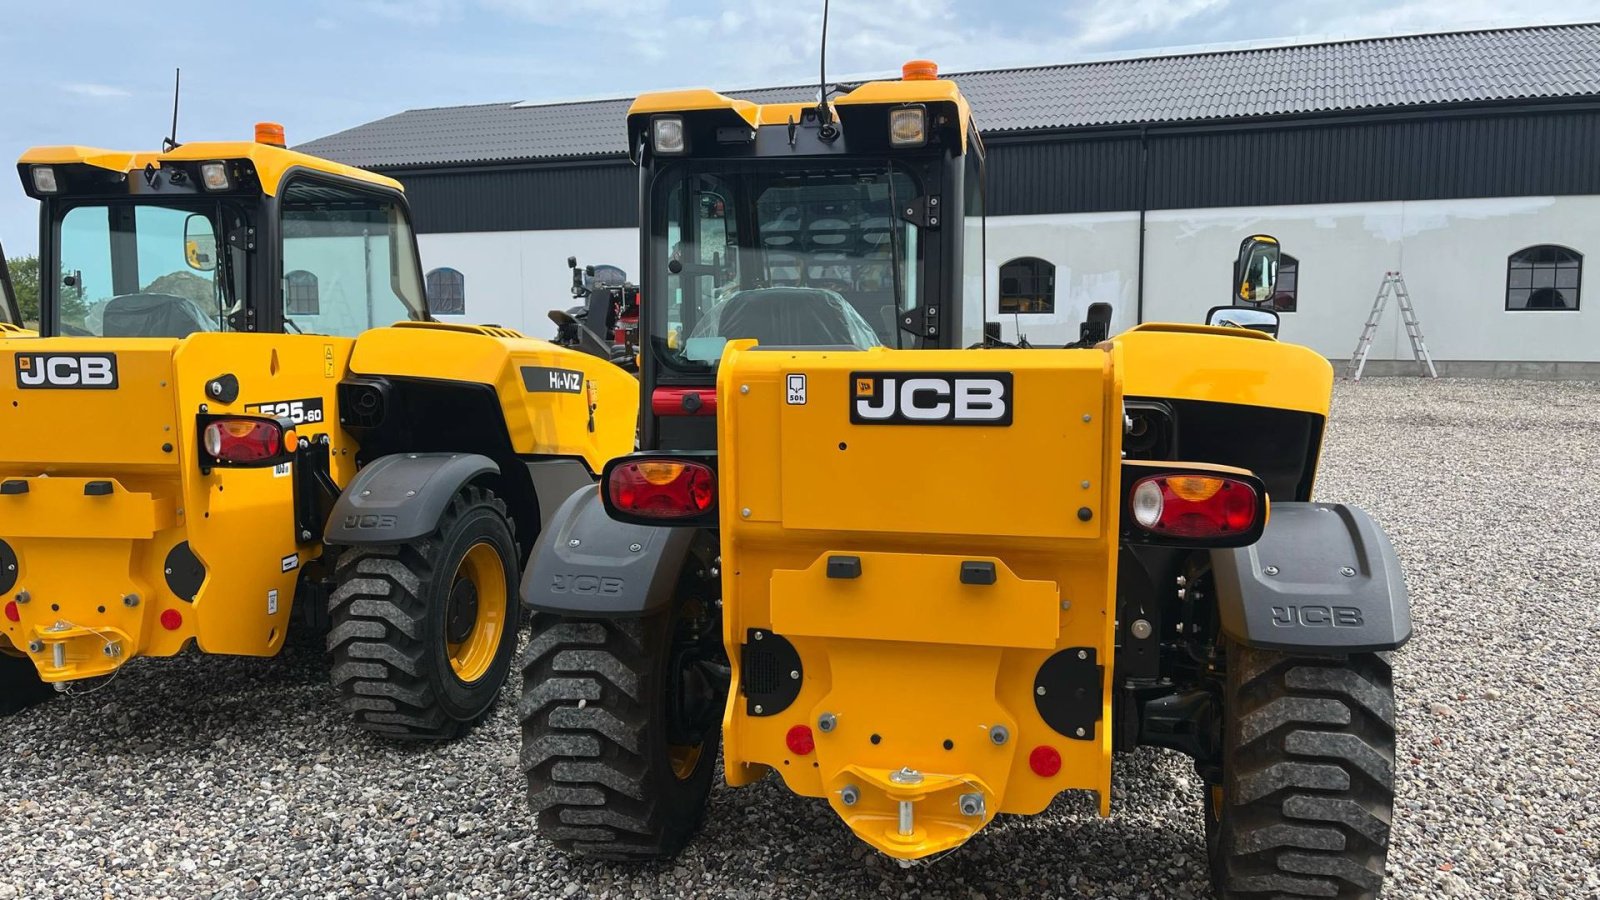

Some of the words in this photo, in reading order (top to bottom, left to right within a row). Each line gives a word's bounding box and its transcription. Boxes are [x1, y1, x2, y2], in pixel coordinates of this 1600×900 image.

[20, 356, 114, 385] JCB
[856, 378, 1006, 420] JCB
[344, 514, 398, 530] JCB
[551, 574, 625, 597] JCB
[1271, 605, 1365, 629] JCB
